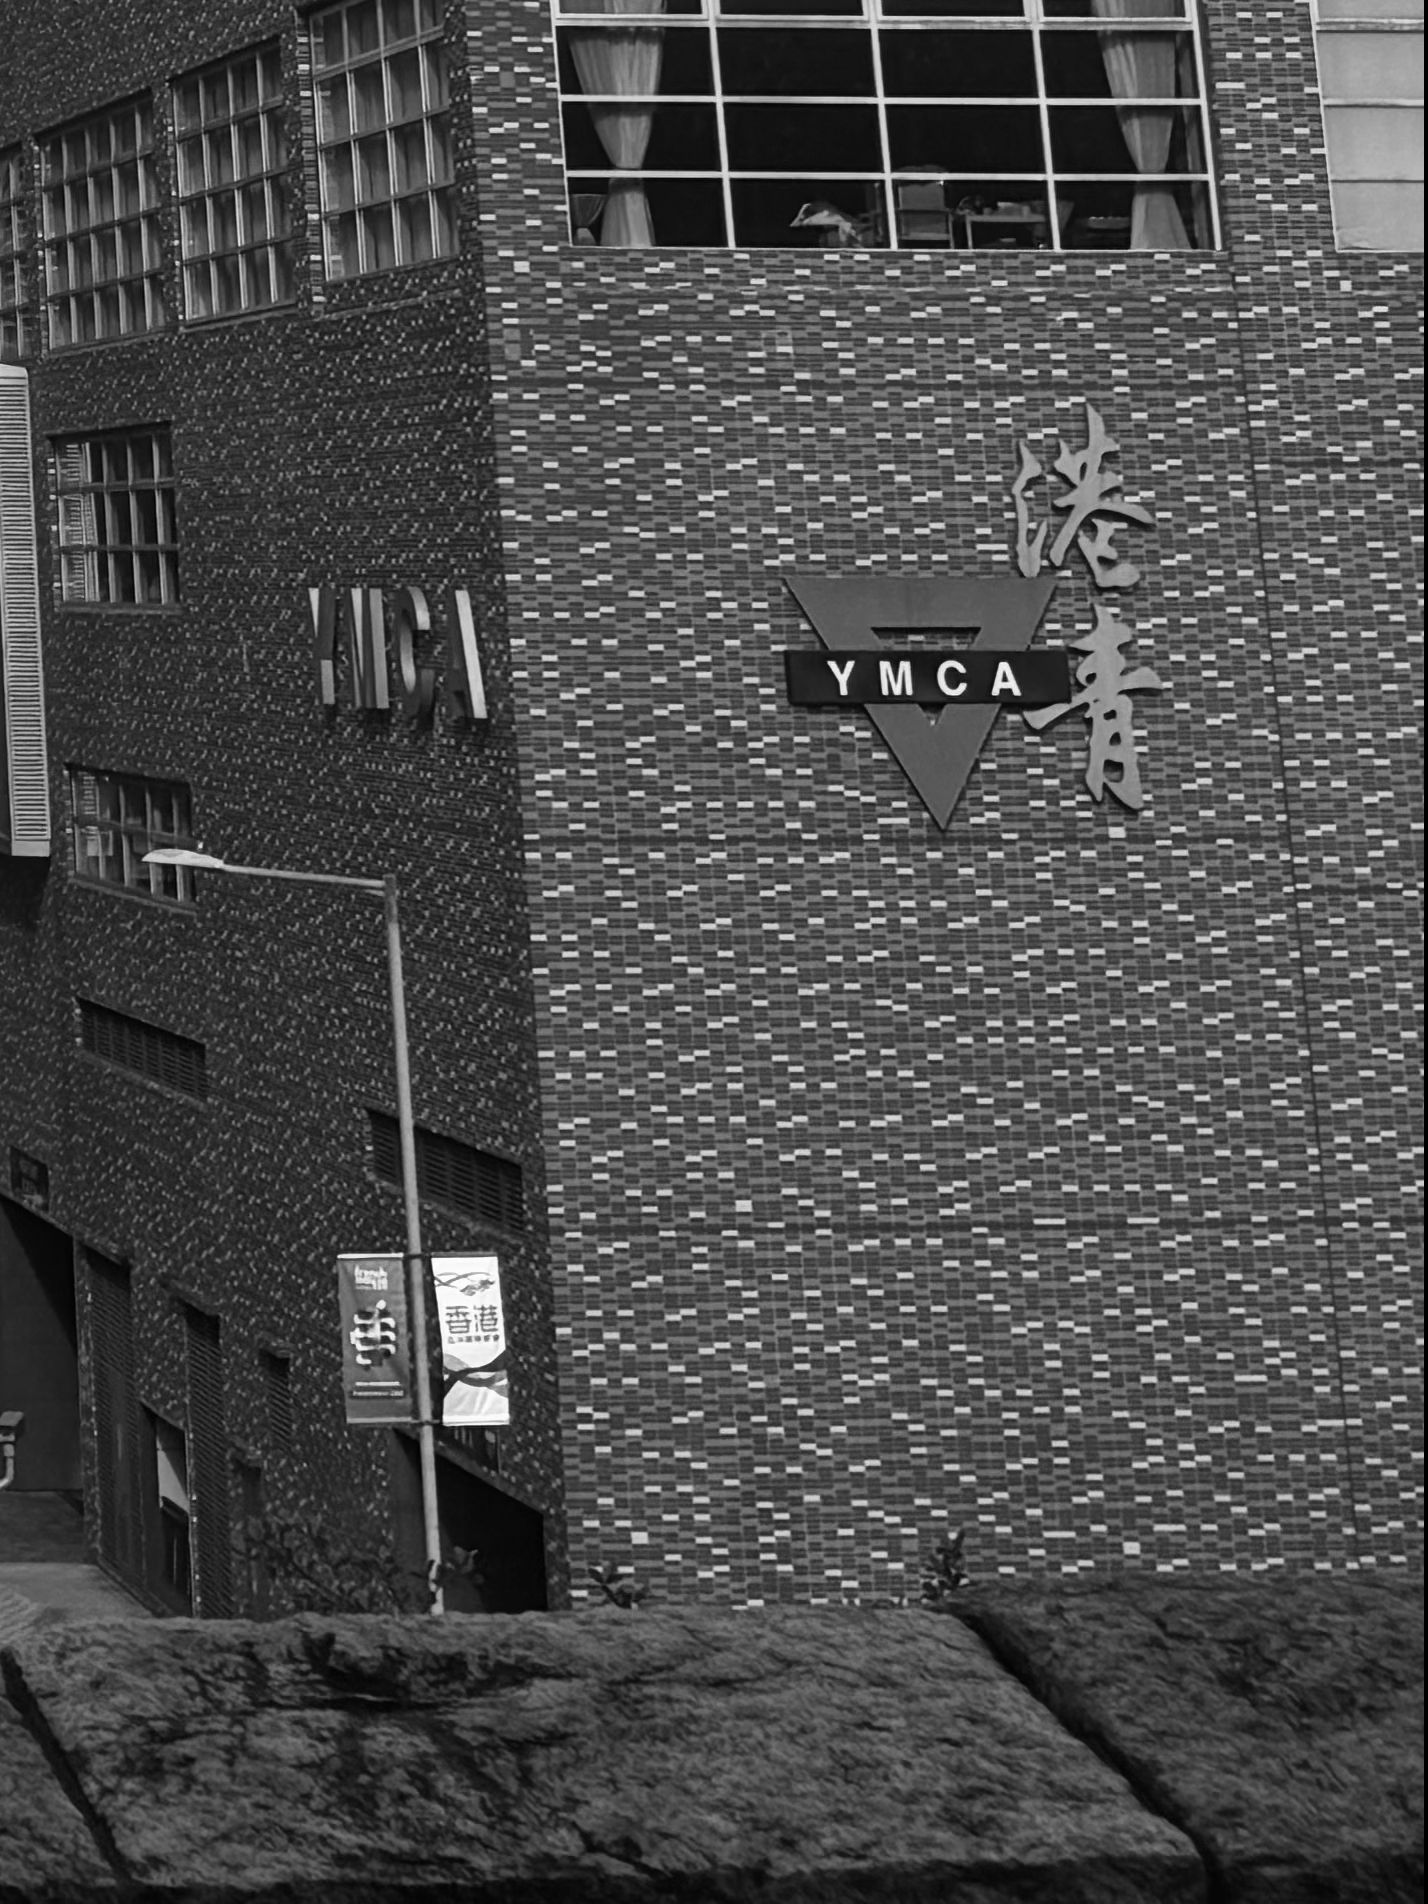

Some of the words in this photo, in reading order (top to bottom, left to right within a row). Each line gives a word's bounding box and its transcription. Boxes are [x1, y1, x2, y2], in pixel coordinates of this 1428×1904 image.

[1009, 403, 1162, 812] 港青
[308, 587, 489, 722] YMCA
[826, 660, 1022, 698] YMCA
[445, 1304, 499, 1334] 香港
